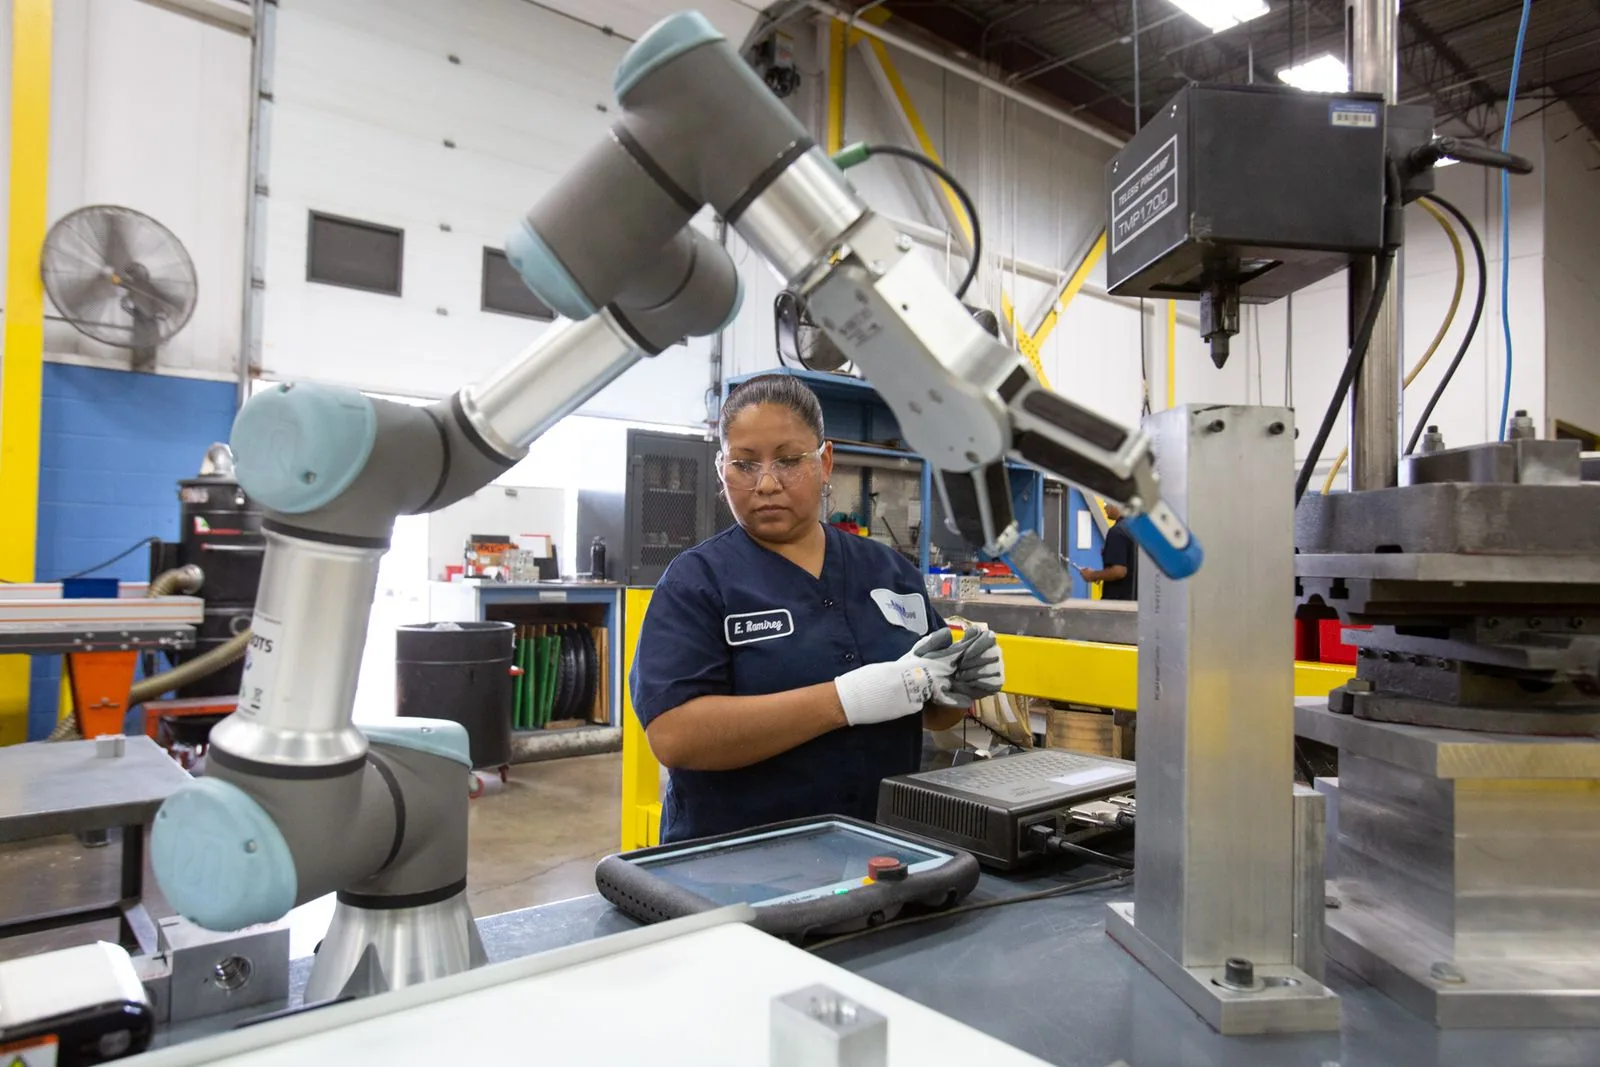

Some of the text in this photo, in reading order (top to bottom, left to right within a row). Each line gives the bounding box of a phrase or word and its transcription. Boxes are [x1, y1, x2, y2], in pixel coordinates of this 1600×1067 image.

[1118, 187, 1168, 237] TMP1700
[734, 619, 783, 635] E. Ramirez
